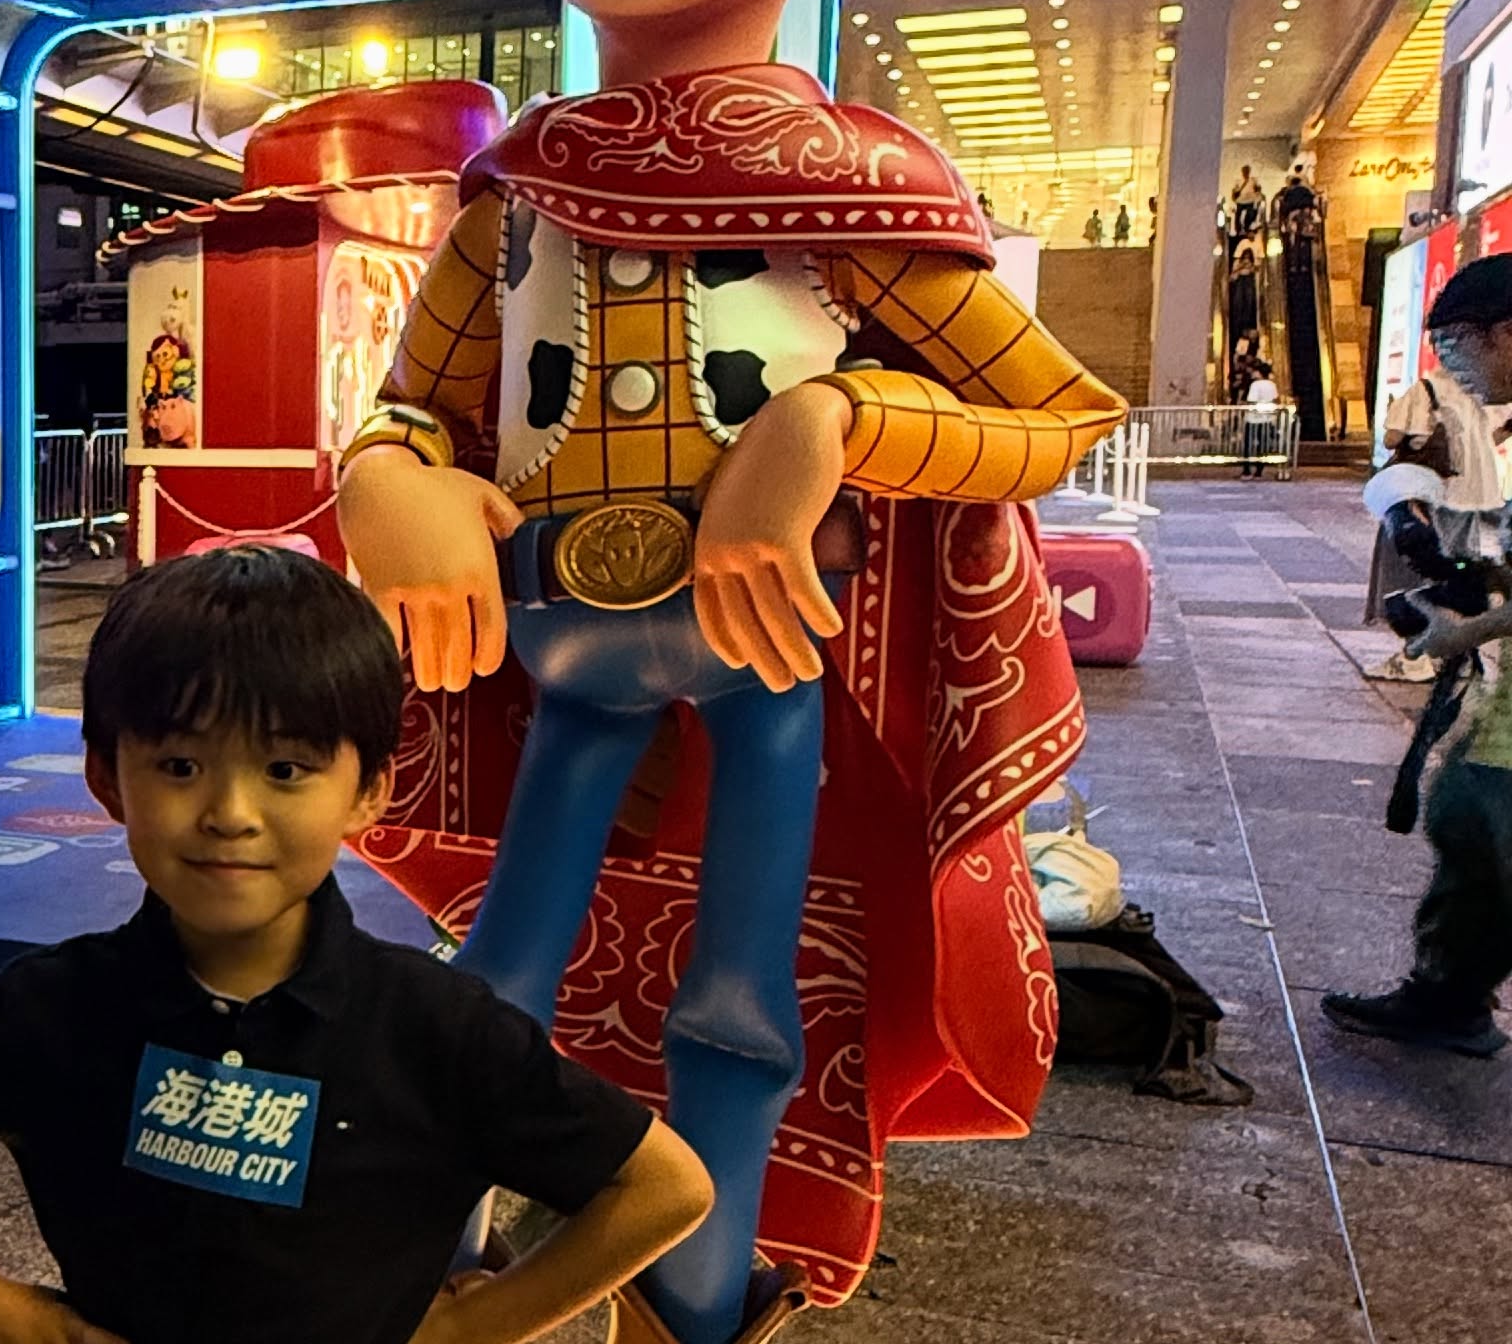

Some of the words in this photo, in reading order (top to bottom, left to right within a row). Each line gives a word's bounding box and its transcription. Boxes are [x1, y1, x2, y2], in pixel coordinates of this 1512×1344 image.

[140, 1067, 308, 1149] 海港城
[135, 1128, 240, 1177] HARBOUR
[239, 1153, 298, 1187] CITY
